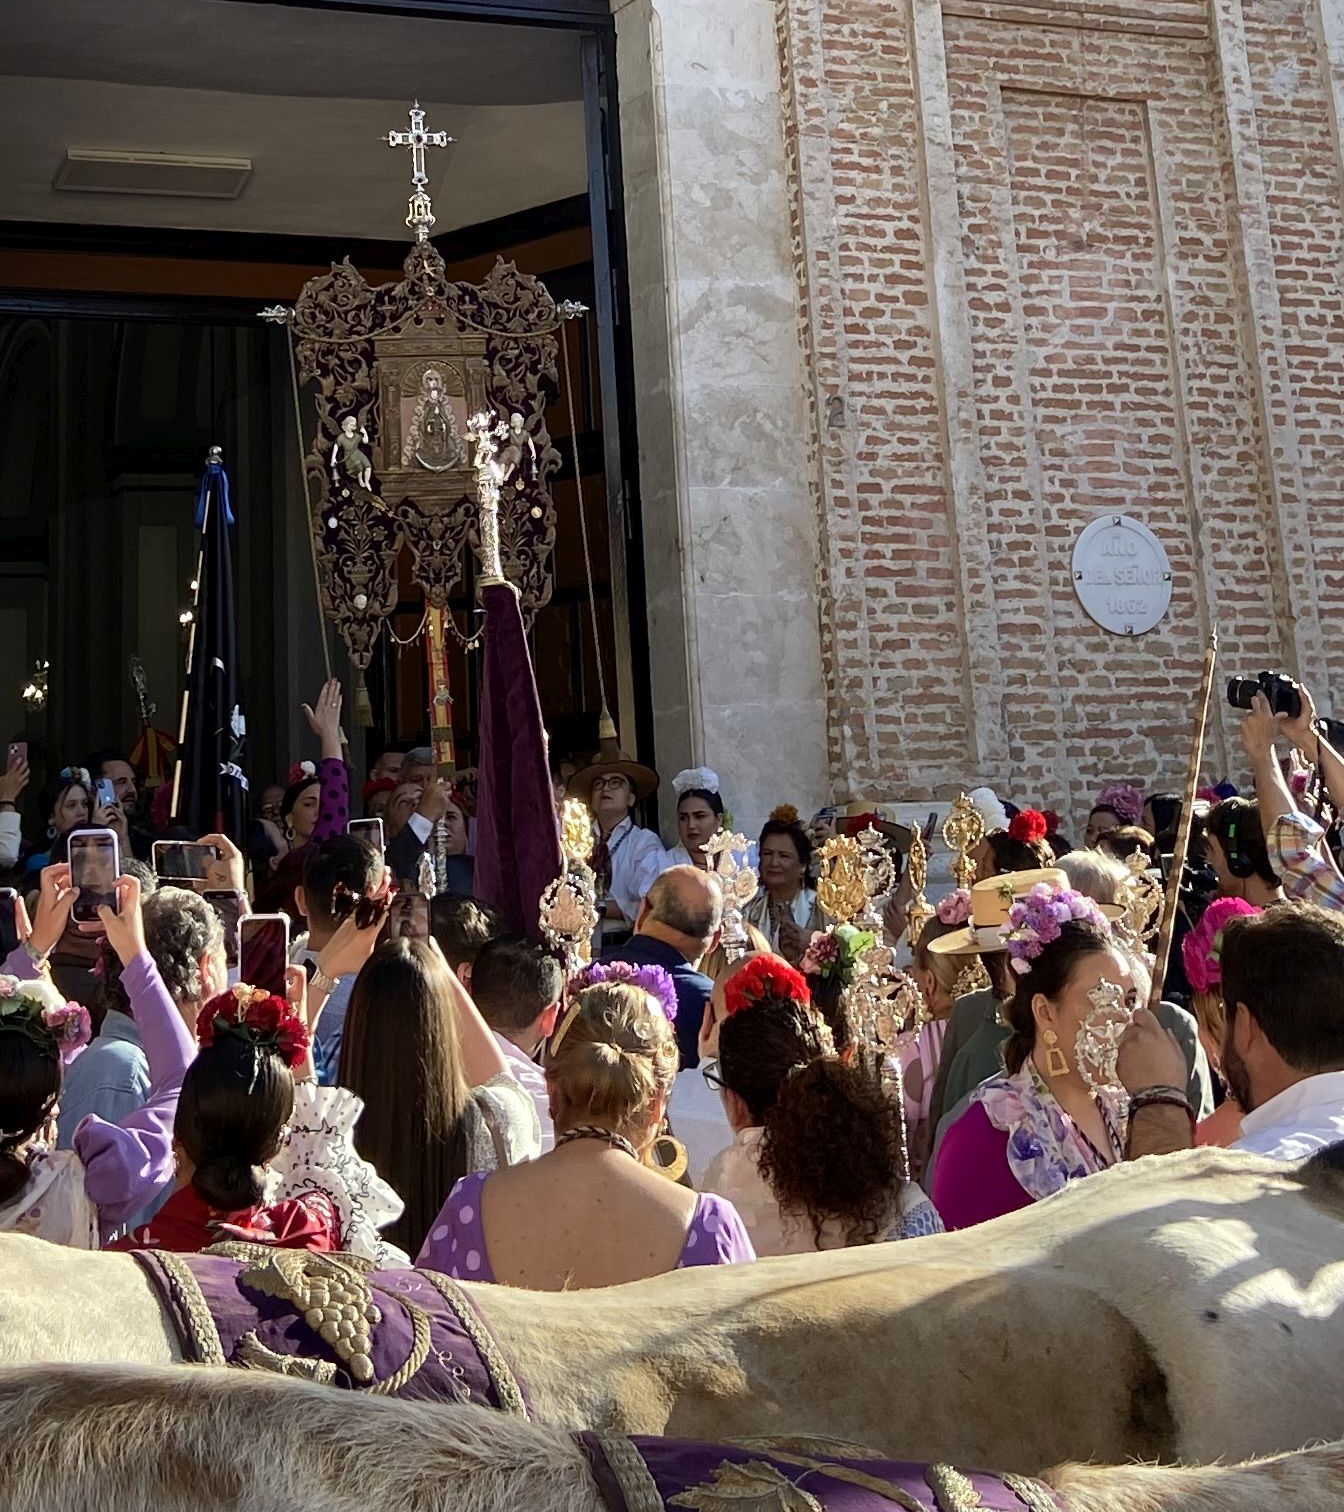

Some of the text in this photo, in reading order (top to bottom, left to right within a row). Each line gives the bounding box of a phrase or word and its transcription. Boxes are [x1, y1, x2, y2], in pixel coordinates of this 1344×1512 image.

[1101, 534, 1137, 556] AÑO
[1085, 565, 1162, 585] DEL SEÑOR
